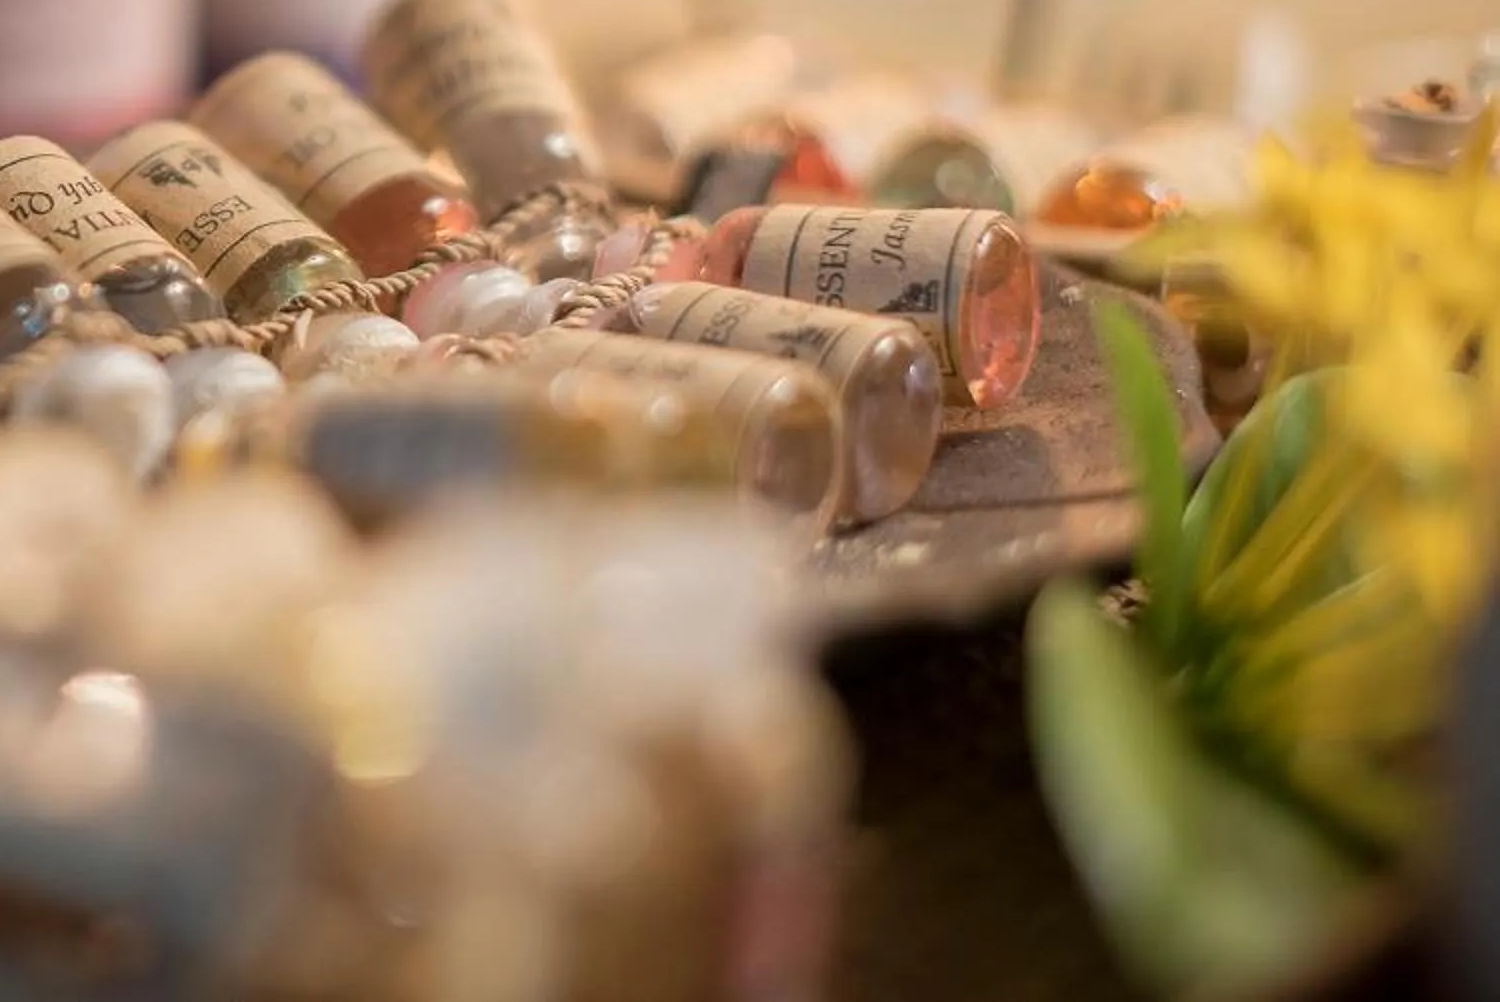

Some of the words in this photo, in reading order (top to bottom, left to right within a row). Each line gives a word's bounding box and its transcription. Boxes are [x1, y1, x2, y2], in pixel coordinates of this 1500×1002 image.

[7, 190, 55, 223] Qu
[176, 193, 253, 254] ESSE
[815, 213, 864, 309] SSENT
[699, 296, 754, 345] ESS
